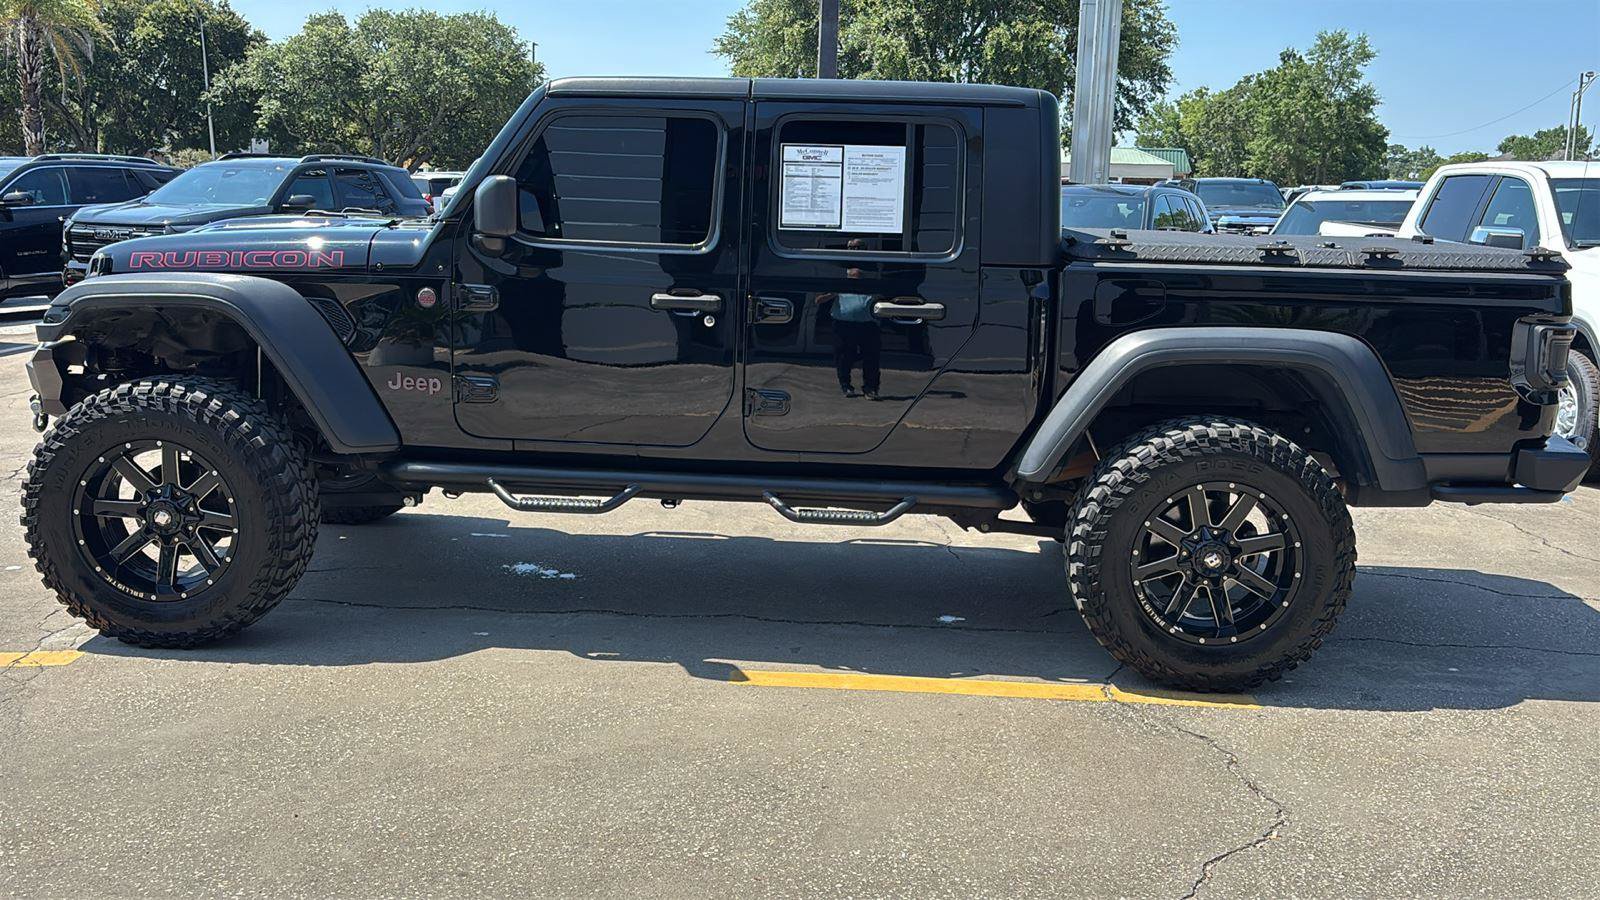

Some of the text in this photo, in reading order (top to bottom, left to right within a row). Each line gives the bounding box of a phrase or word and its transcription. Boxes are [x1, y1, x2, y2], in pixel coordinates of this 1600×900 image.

[94, 229, 130, 240] GMC
[129, 251, 344, 268] RUBICON
[388, 372, 441, 395] Jeep
[1195, 457, 1266, 475] BOSS
[105, 574, 144, 598] BALLISTIC
[1137, 592, 1166, 627] BALLISTIC
